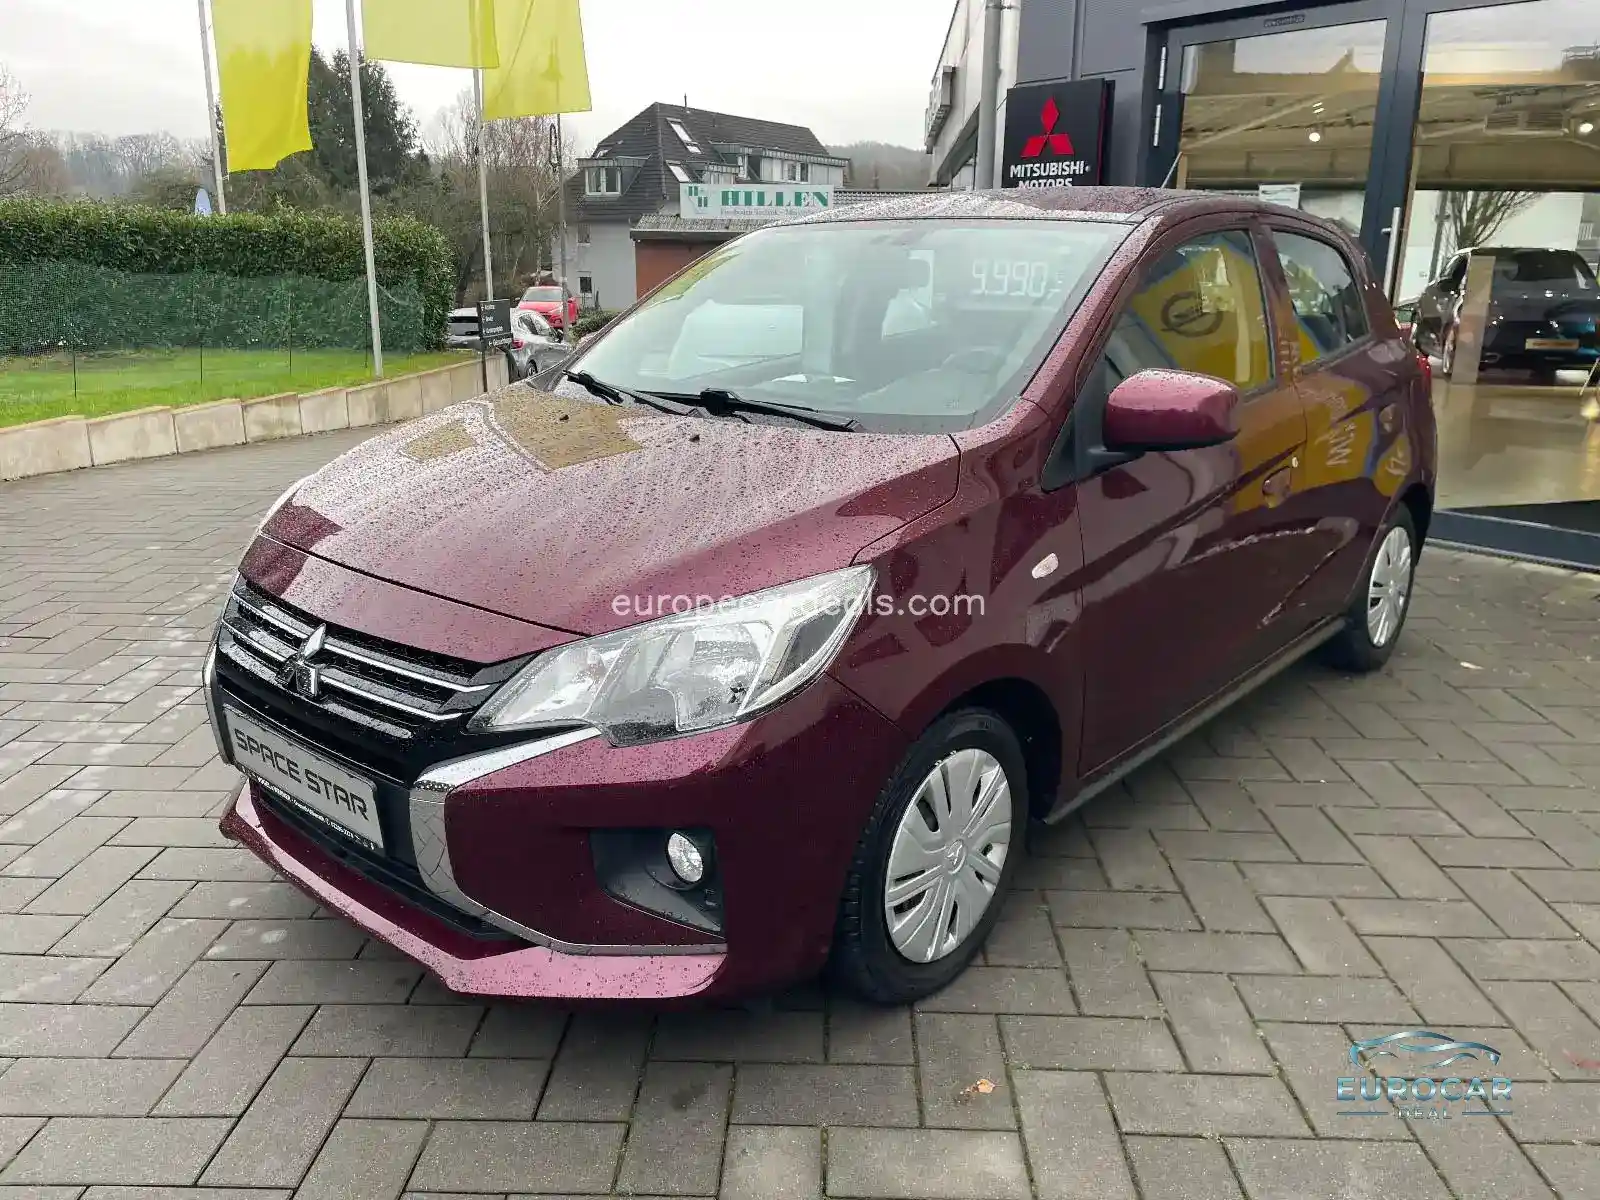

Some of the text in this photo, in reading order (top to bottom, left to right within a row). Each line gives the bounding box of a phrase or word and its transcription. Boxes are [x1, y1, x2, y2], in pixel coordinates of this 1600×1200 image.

[1009, 160, 1084, 178] MITSUBISHI
[720, 190, 829, 206] HILLEN
[234, 728, 302, 784] SPACE
[304, 768, 370, 822] STAR
